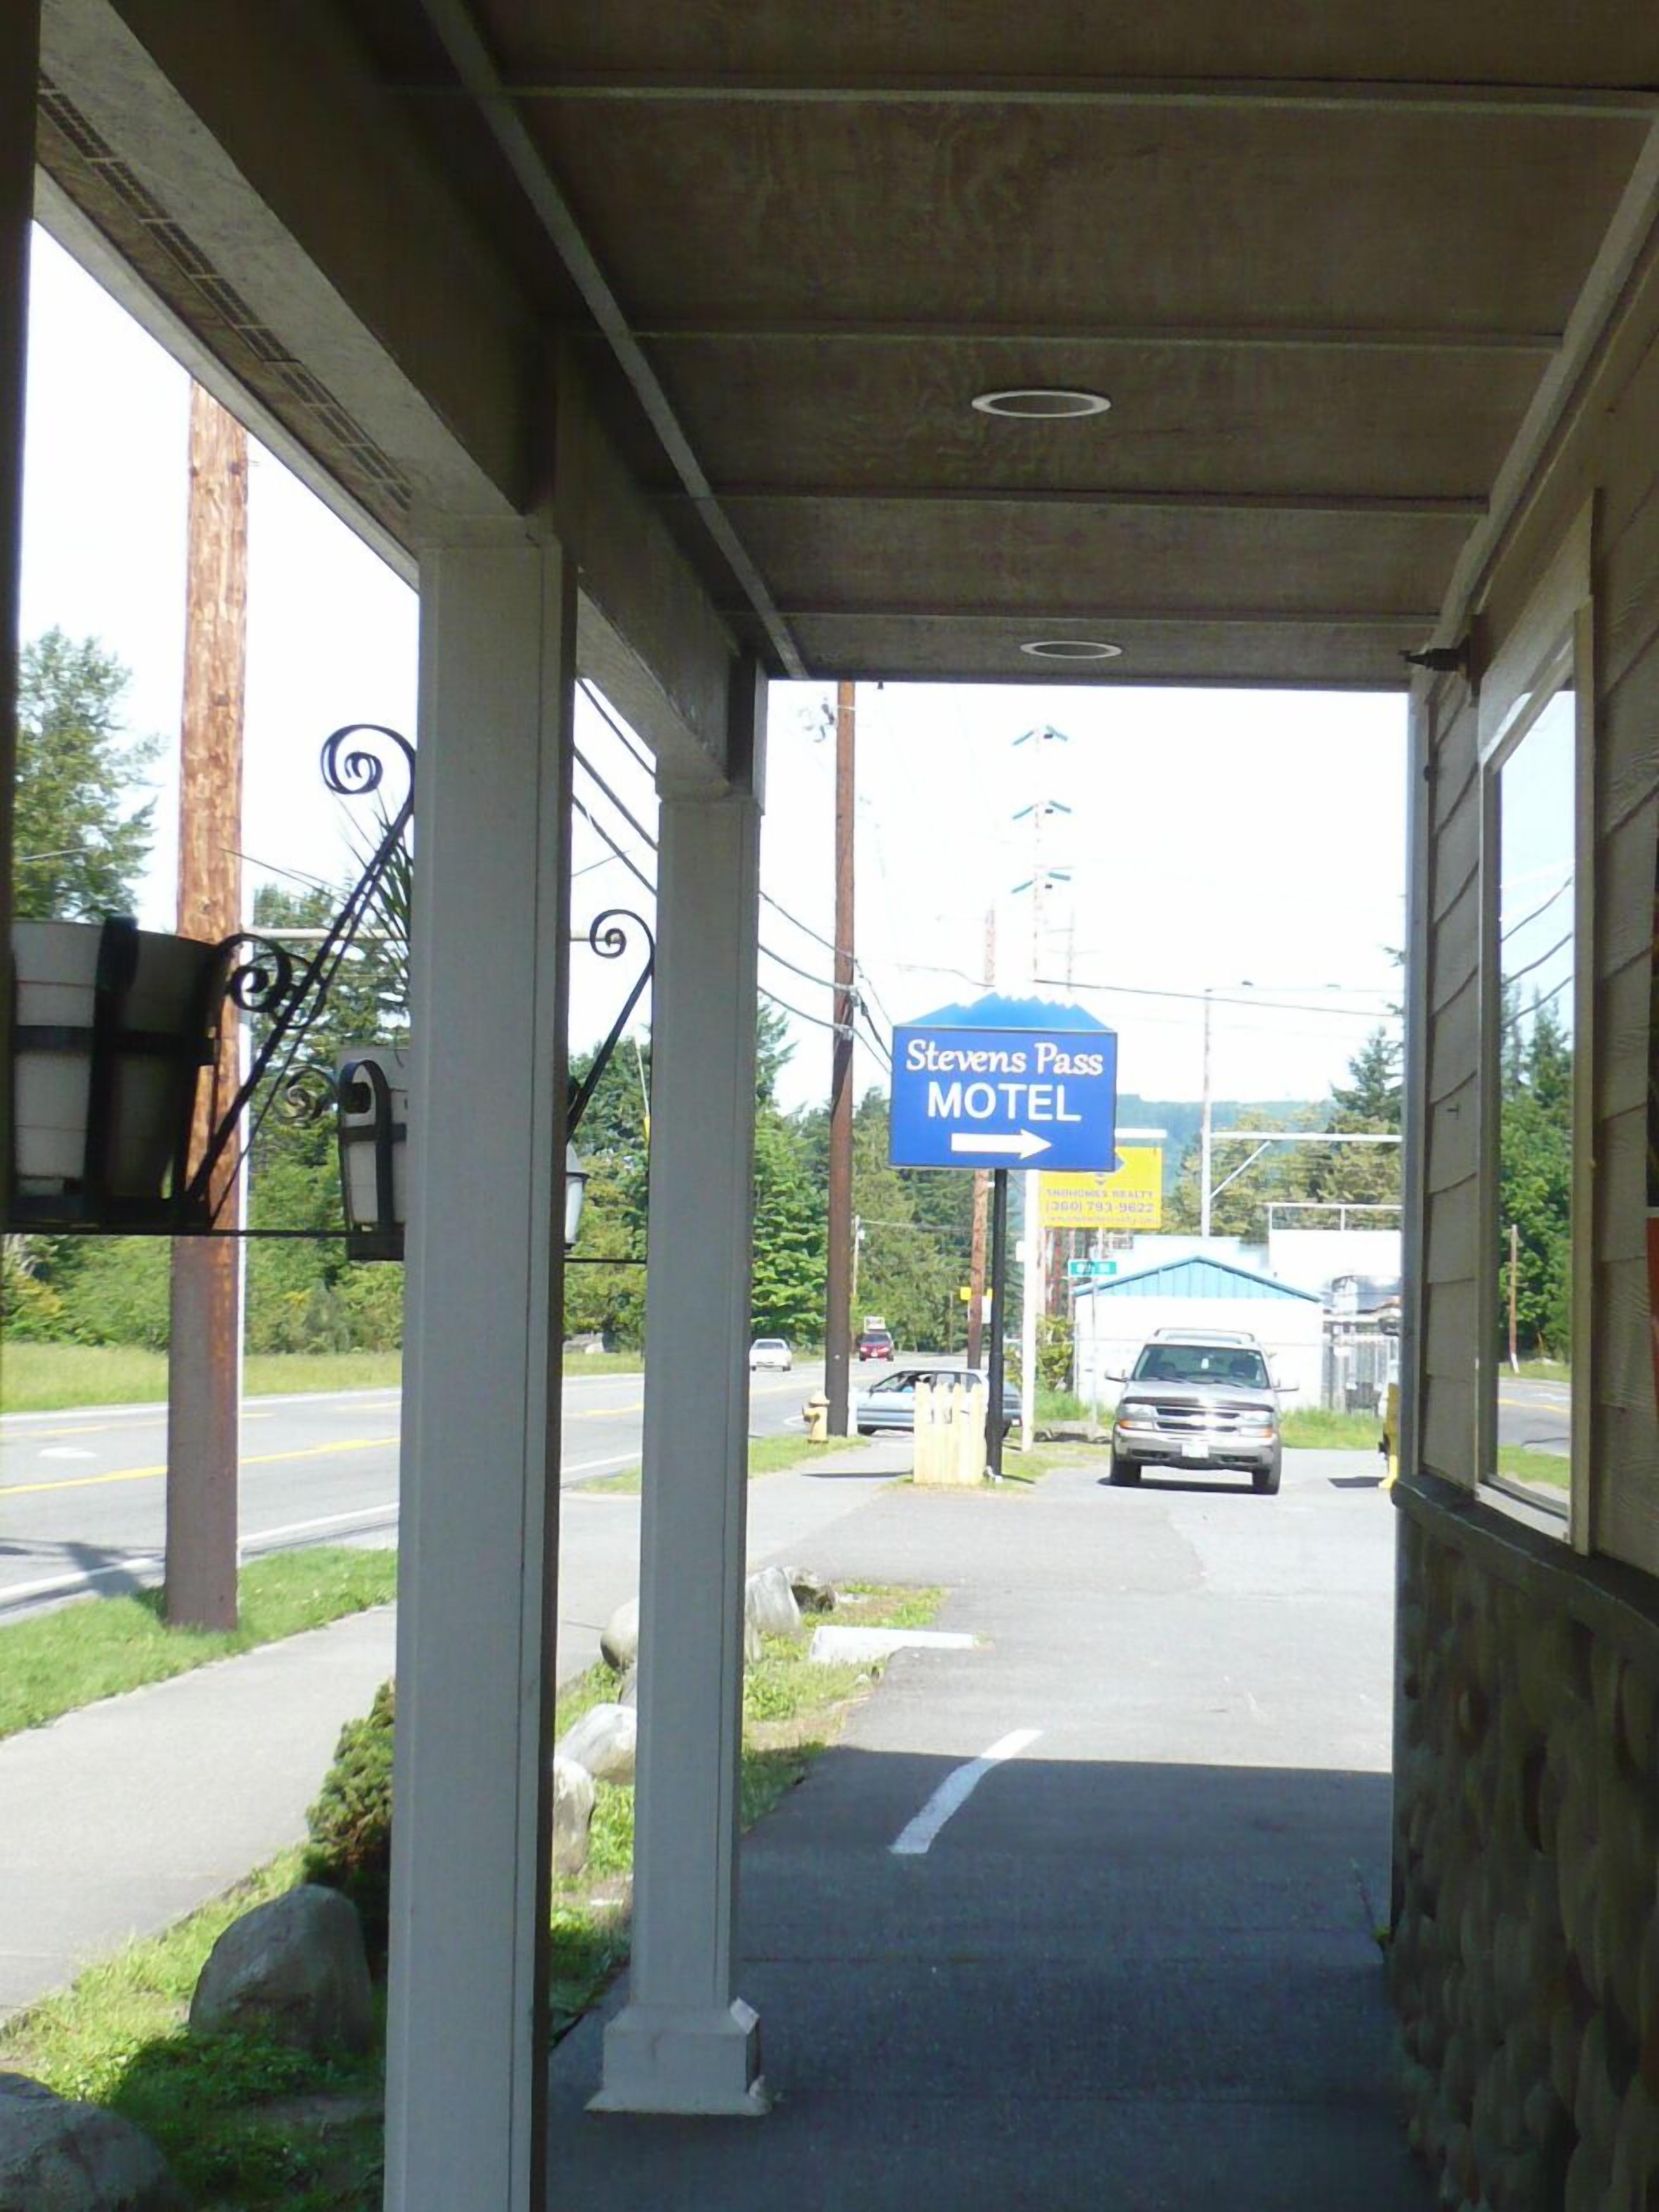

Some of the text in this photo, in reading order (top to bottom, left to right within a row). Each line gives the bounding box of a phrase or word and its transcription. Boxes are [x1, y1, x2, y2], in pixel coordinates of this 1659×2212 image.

[906, 1039, 1104, 1076] Stevens Pass
[927, 1081, 1082, 1122] MOTEL
